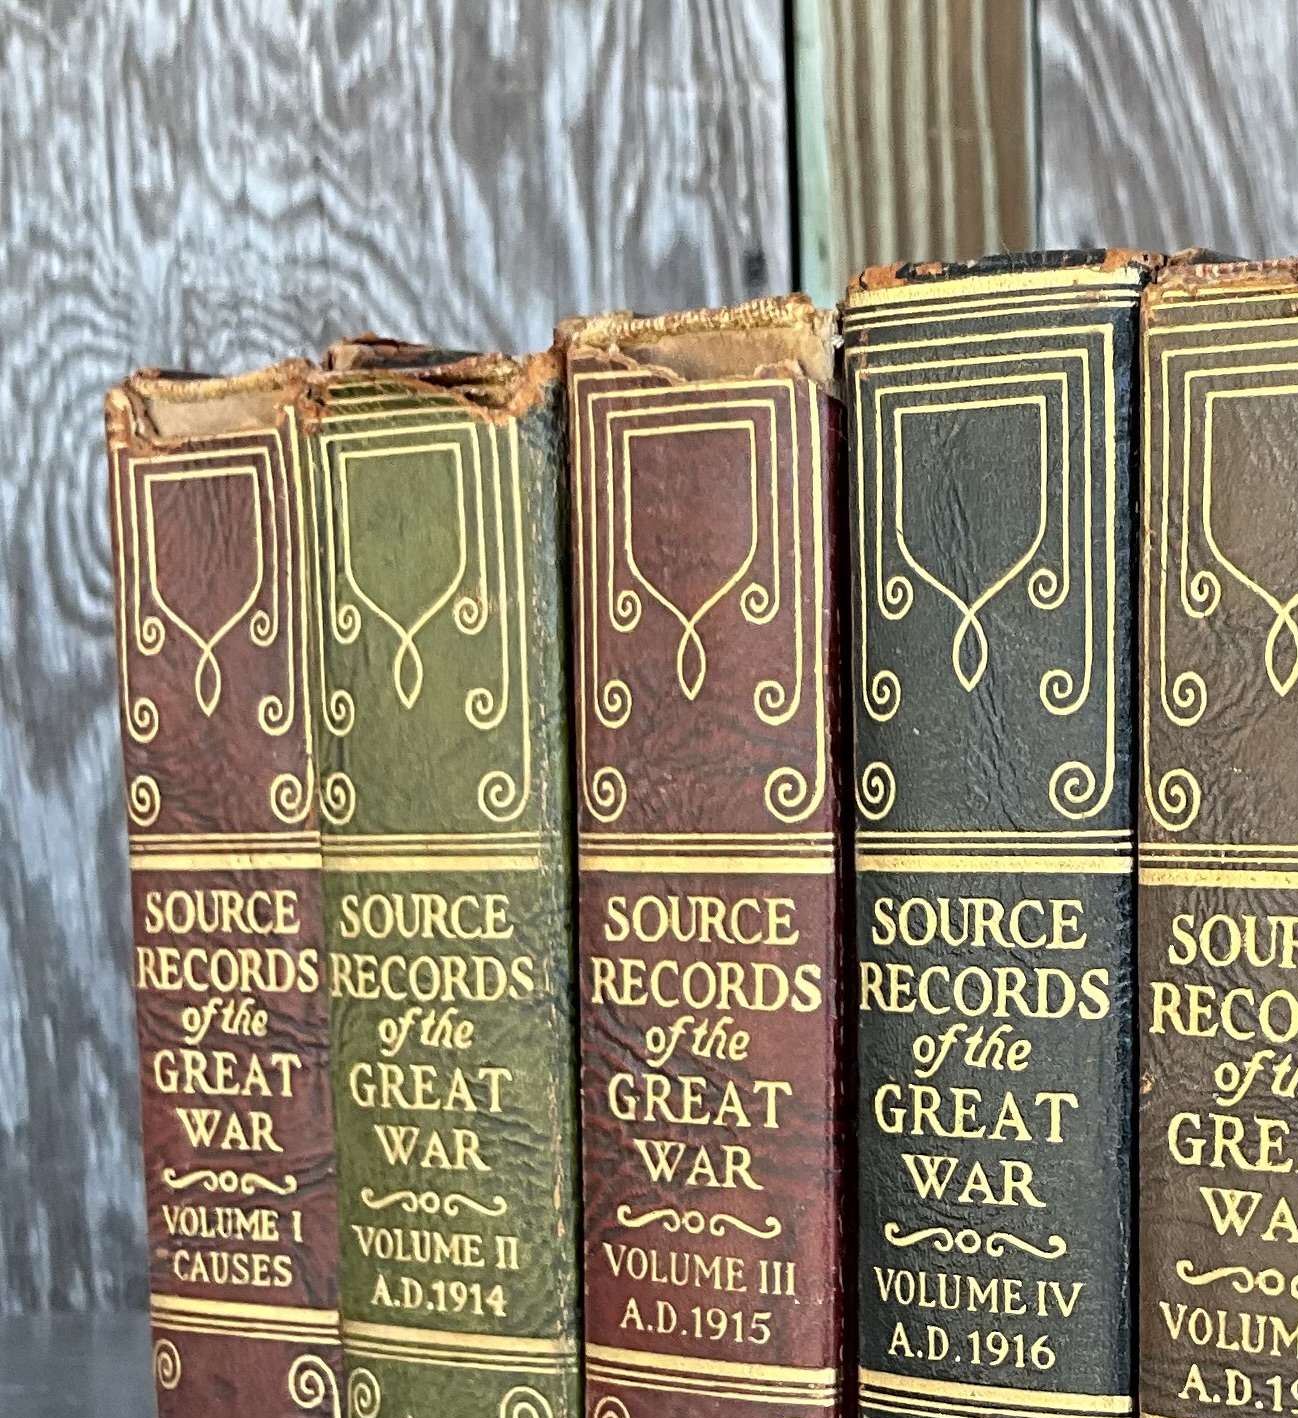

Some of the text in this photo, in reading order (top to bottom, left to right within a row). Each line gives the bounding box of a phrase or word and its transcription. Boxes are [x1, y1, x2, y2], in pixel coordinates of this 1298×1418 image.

[145, 890, 300, 935] SOURCE
[339, 894, 515, 939] SOURCE
[604, 896, 799, 946] SOURCE
[872, 897, 1087, 950] SOURCE
[137, 947, 319, 993] RECORDS
[330, 952, 534, 1001] RECORDS
[590, 957, 822, 1012] RECORDS
[860, 962, 1110, 1020] RECORDS
[182, 997, 267, 1045] of the
[379, 1006, 474, 1057] of the
[646, 1016, 750, 1068] of the
[153, 1049, 301, 1097] GREAT
[913, 1023, 1032, 1078] of the
[349, 1062, 513, 1113] GREAT
[608, 1073, 793, 1129] GREAT
[1213, 1049, 1274, 1107] of
[175, 1107, 283, 1153] WAR
[874, 1084, 1078, 1144] GREAT
[374, 1124, 491, 1172] WAR
[633, 1139, 763, 1191] WAR
[901, 1154, 1047, 1208] WAR
[162, 1204, 302, 1242] VOLUME I
[352, 1224, 519, 1270] VOLUME II
[173, 1248, 293, 1287] CAUSES
[602, 1242, 797, 1296] VOLUME III
[874, 1266, 1085, 1319] VOLUME IV
